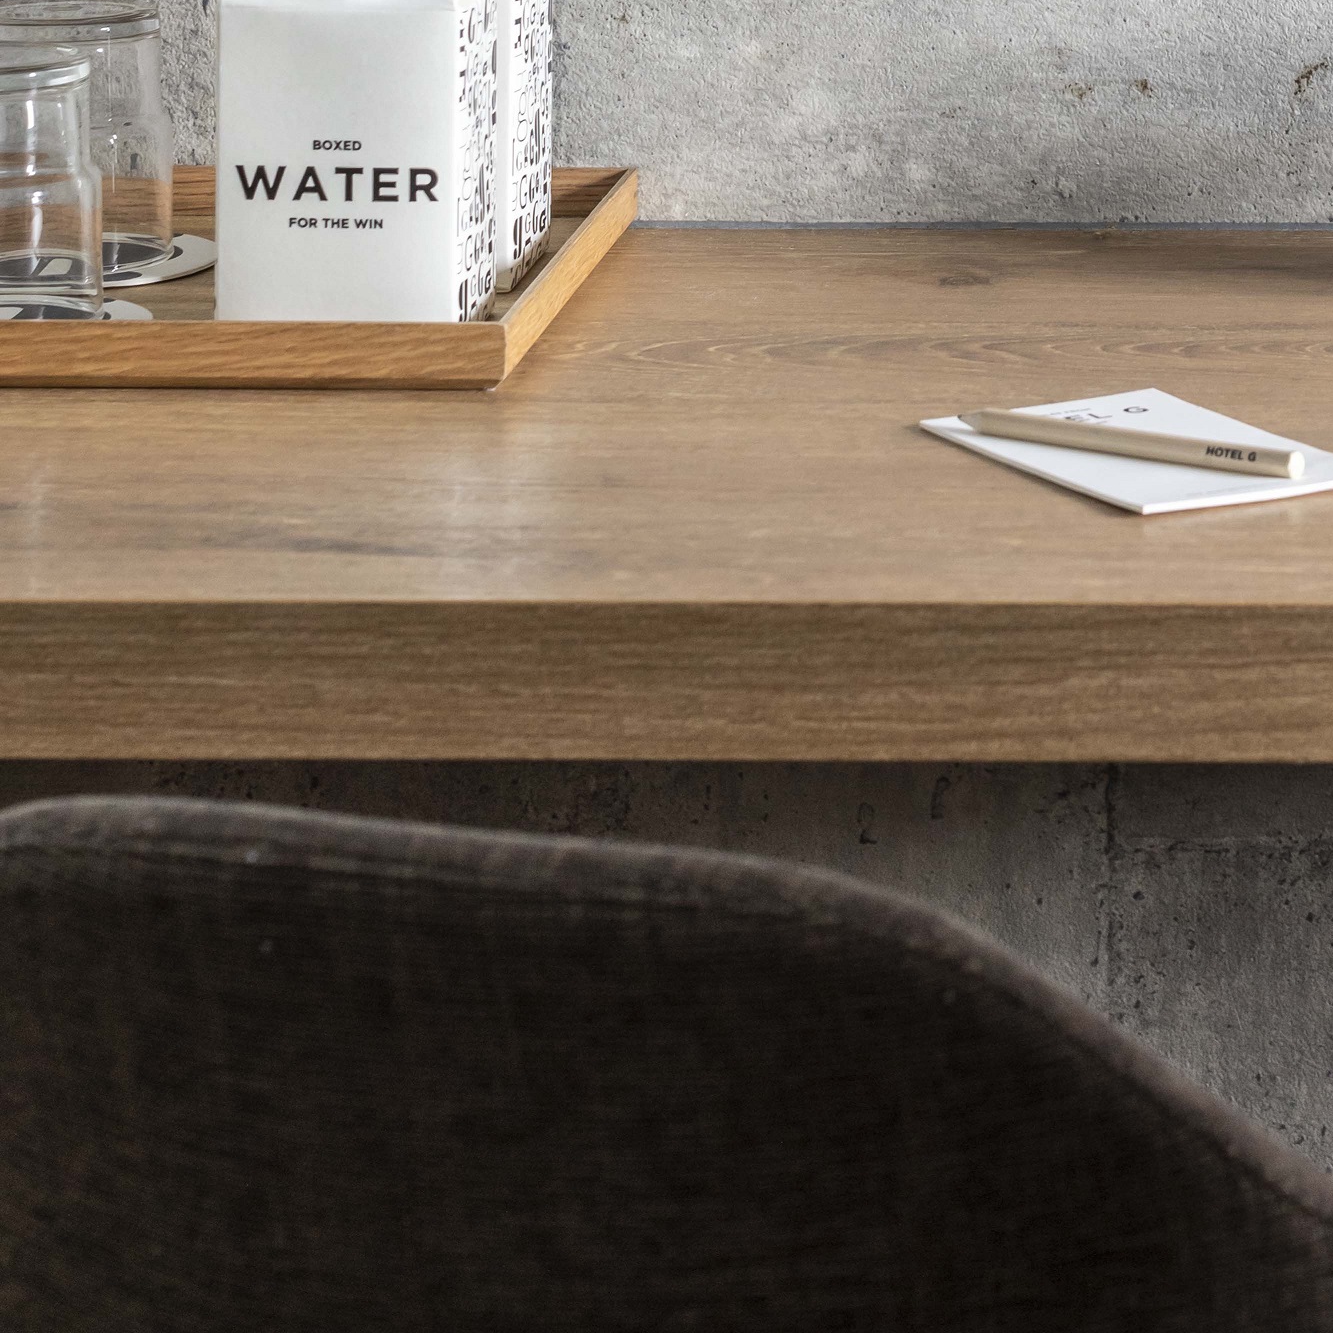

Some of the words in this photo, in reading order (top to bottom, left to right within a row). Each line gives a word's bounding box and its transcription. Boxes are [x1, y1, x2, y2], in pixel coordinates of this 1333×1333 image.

[312, 139, 362, 151] BOXED
[235, 164, 438, 203] WATER
[288, 217, 318, 229] FOR
[322, 217, 350, 229] THE
[354, 218, 384, 229] WIN
[1205, 445, 1244, 461] HOTEL
